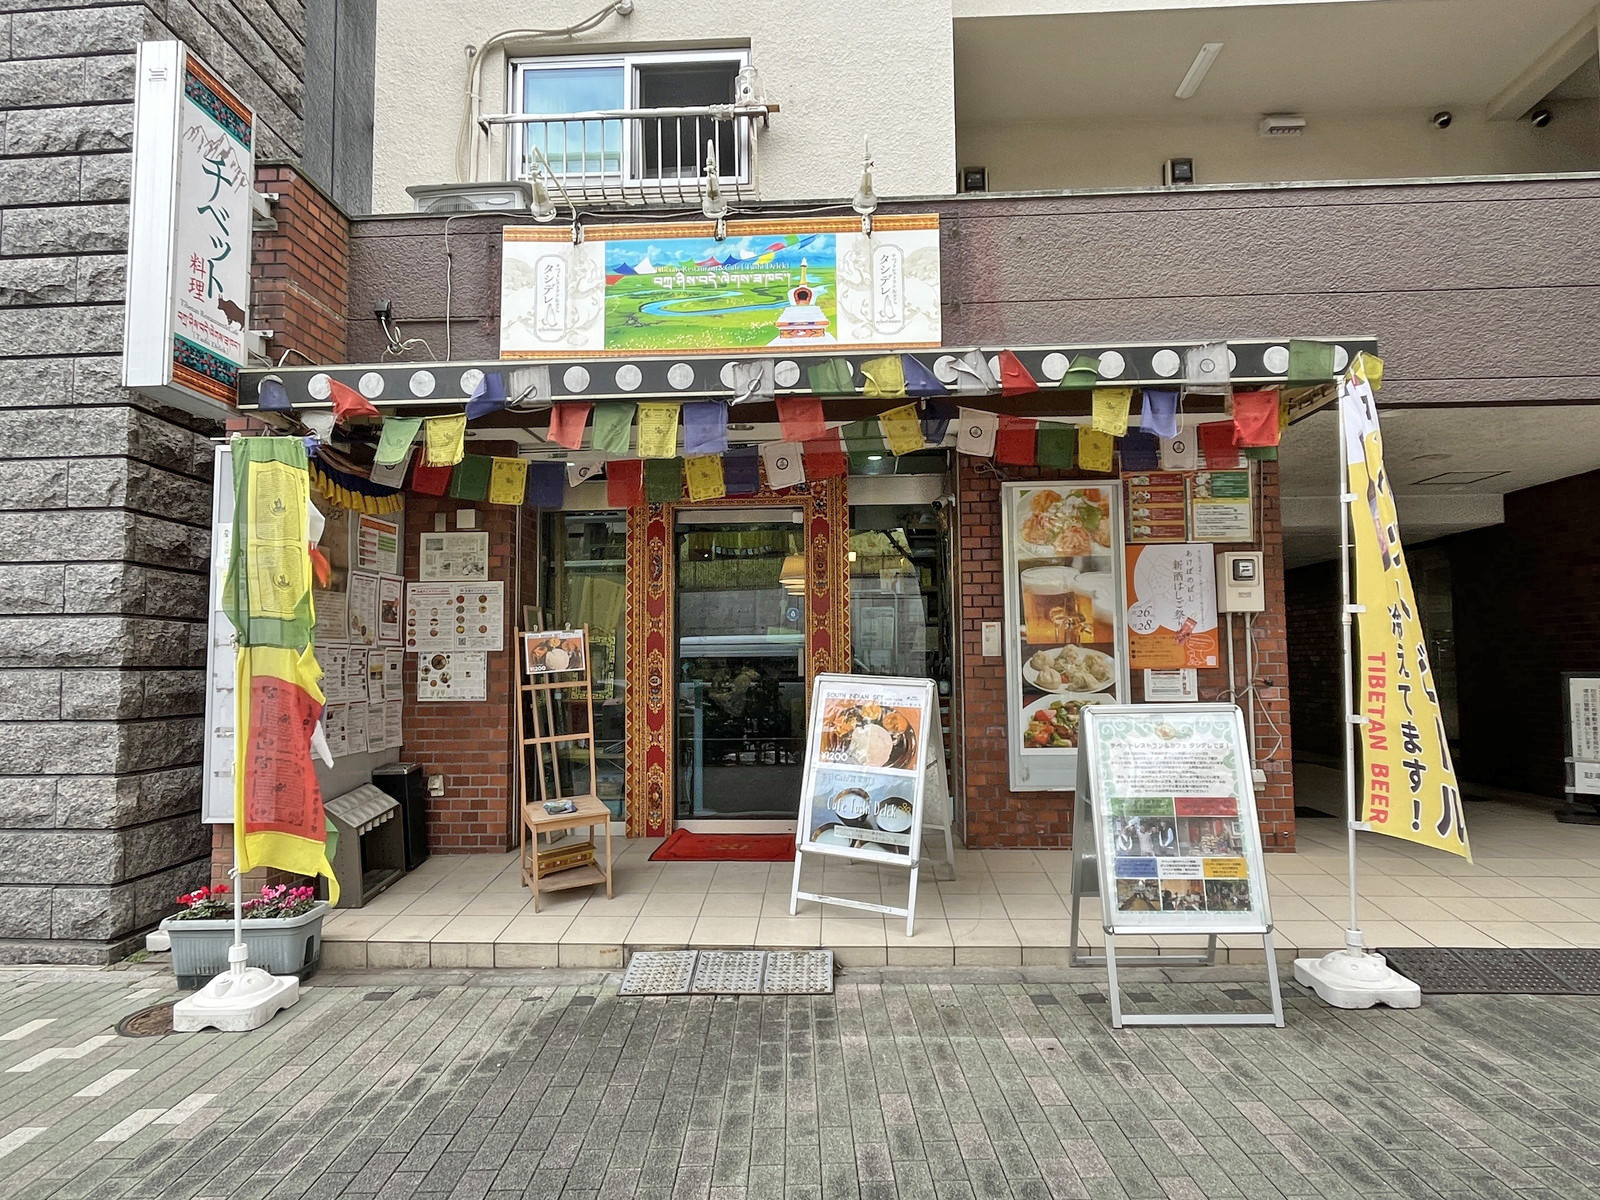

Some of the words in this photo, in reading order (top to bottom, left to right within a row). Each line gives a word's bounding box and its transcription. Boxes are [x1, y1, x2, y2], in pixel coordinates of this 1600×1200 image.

[196, 155, 233, 299] チベット
[188, 251, 207, 303] 料理
[543, 264, 555, 304] タシデレ
[880, 254, 892, 295] タシデレ
[1367, 652, 1389, 751] TIBETAN
[820, 751, 849, 762] ¥1200
[1369, 763, 1390, 825] BEER
